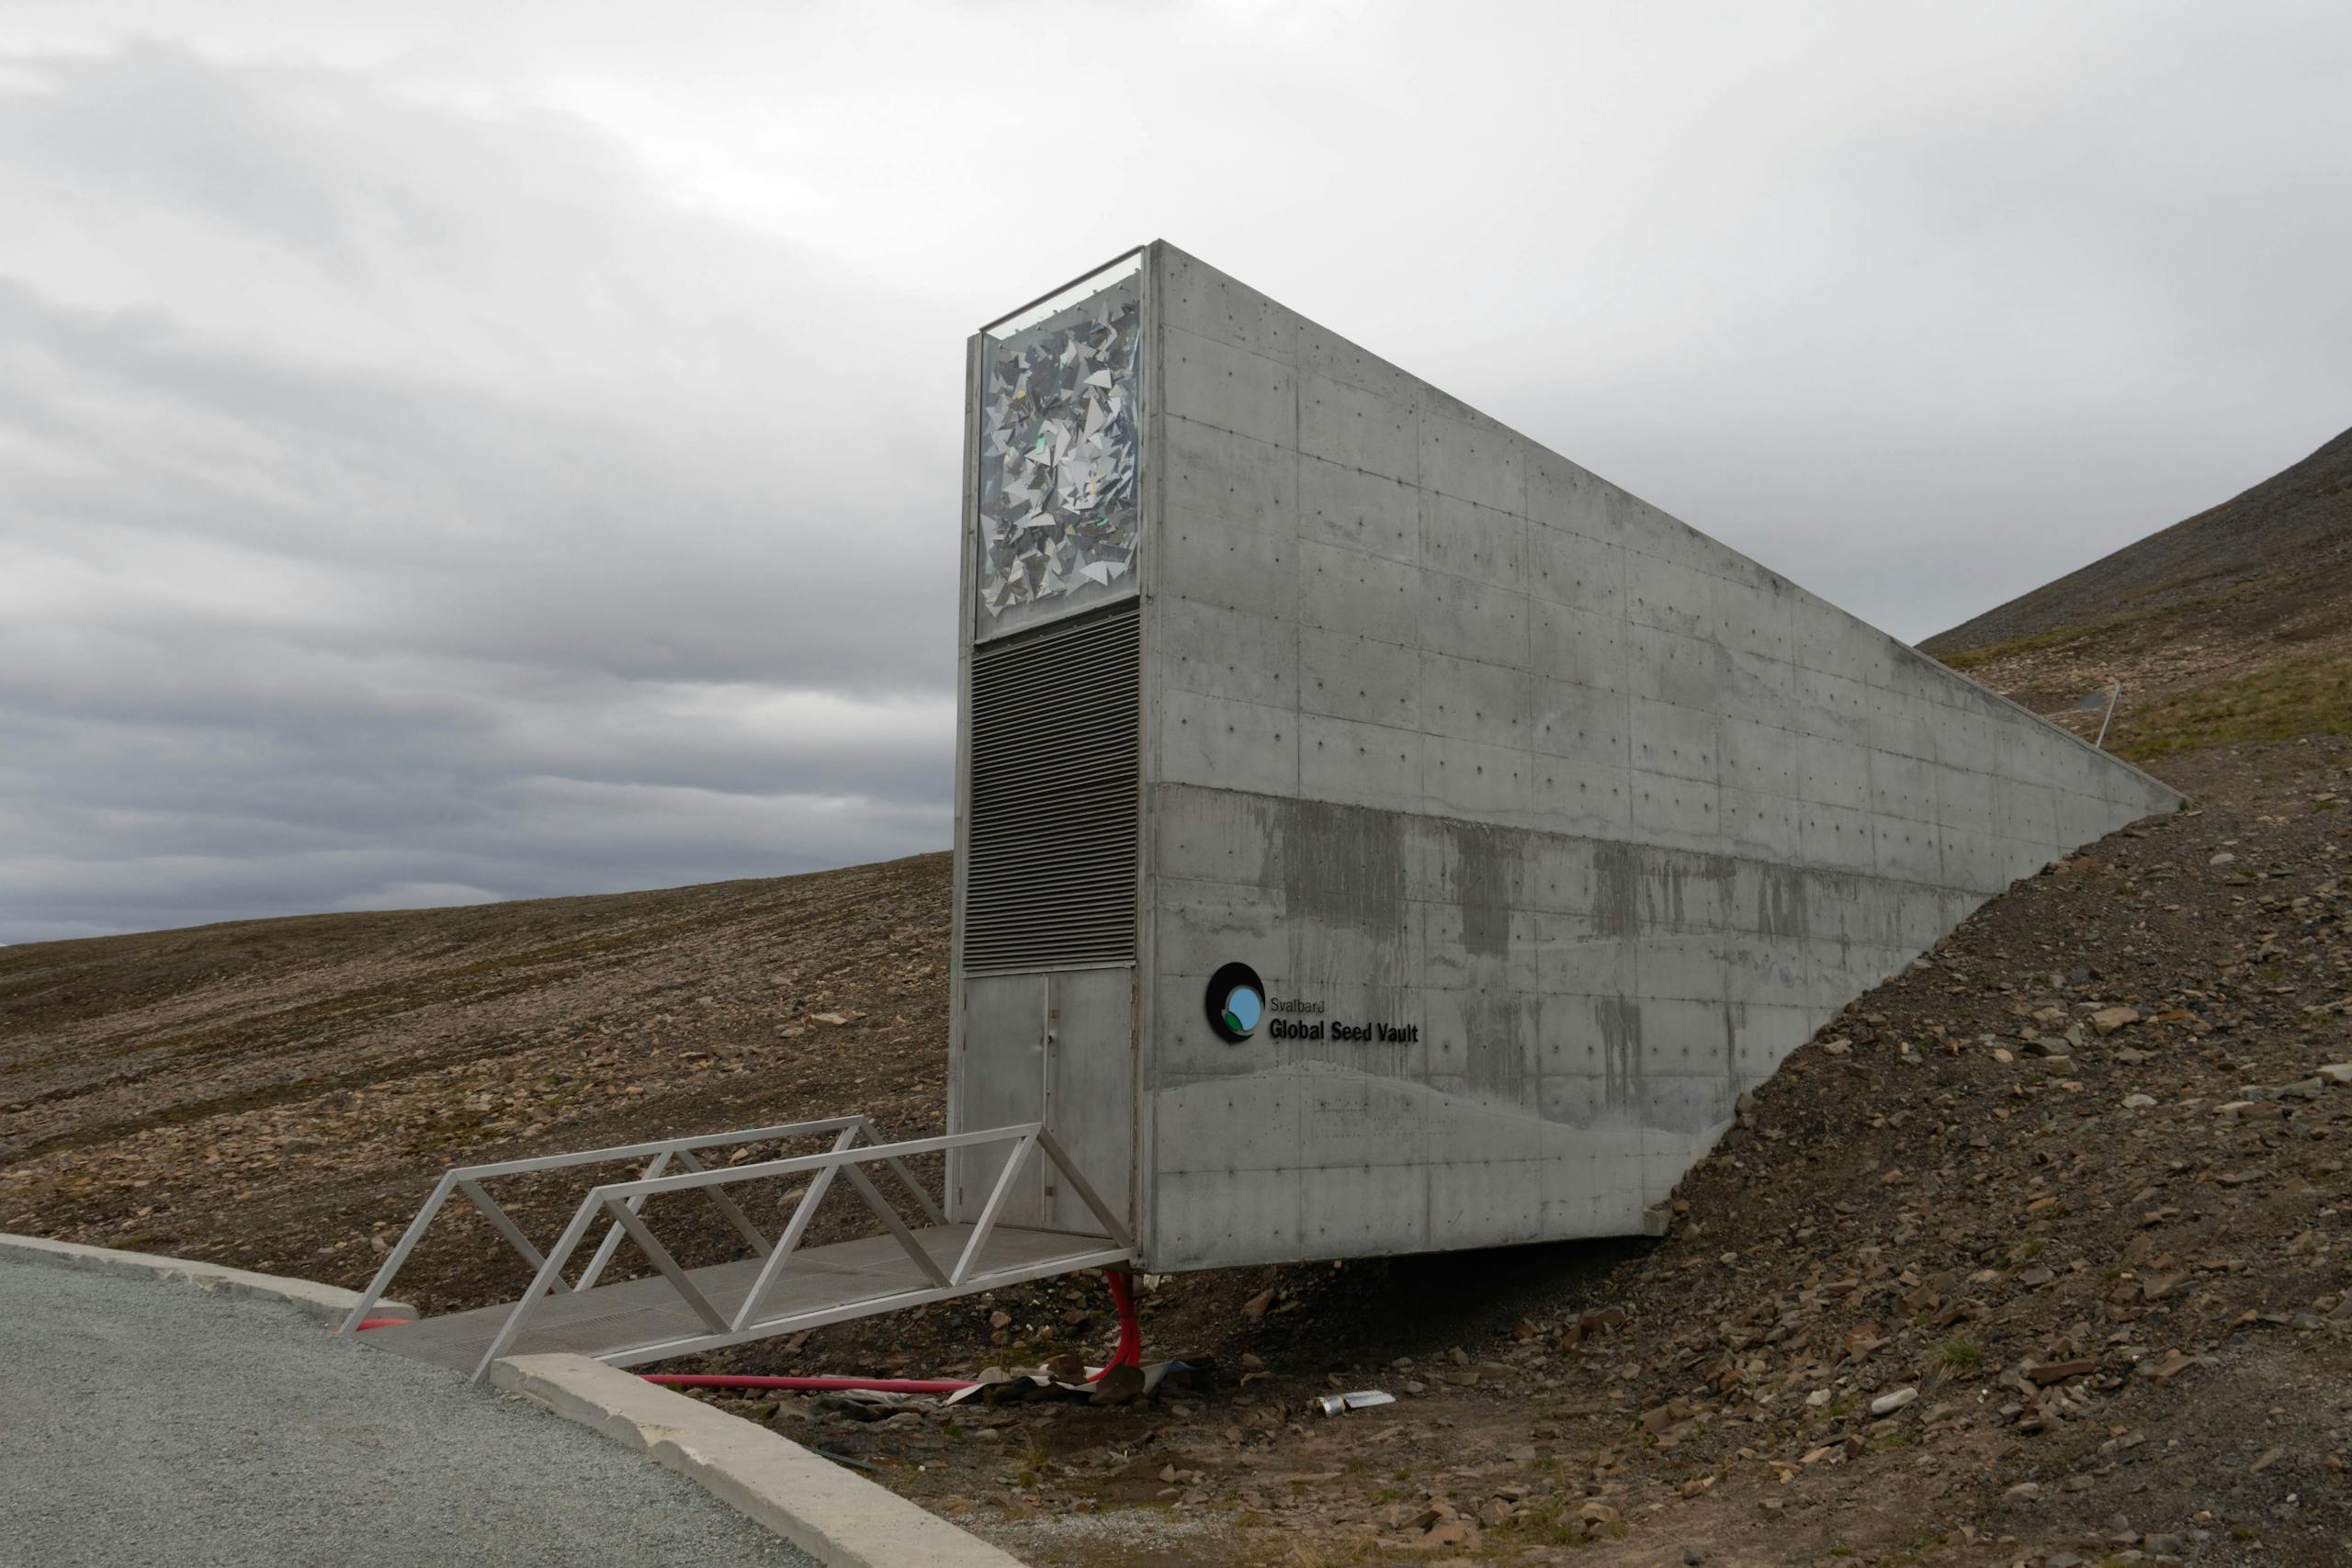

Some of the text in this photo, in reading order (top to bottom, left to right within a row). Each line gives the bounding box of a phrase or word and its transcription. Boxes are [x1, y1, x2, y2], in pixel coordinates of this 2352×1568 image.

[1271, 998, 1325, 1013] Svalbard
[1270, 1019, 1419, 1043] Global Seed Vault
